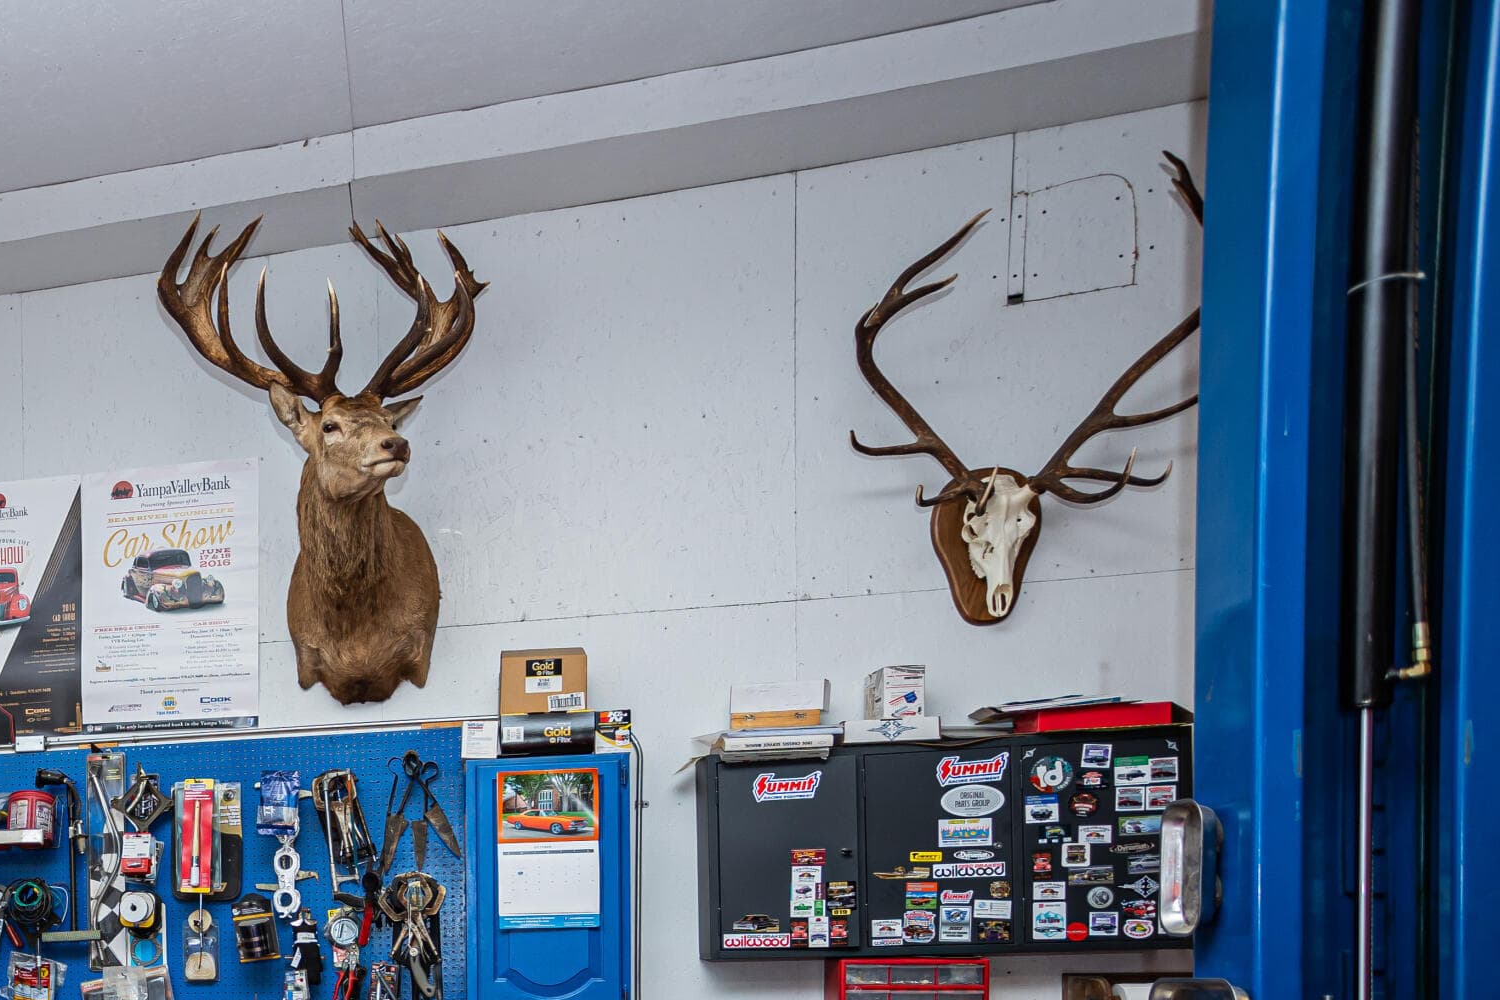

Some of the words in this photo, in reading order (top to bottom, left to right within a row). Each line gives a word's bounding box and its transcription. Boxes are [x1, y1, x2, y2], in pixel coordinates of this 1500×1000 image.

[135, 475, 231, 499] YampaValleyBank
[108, 516, 135, 524] BEAR
[136, 513, 169, 521] RIVER
[173, 509, 208, 517] YOUNG
[209, 507, 234, 515] LIFE
[103, 528, 155, 568] Car
[160, 519, 236, 550] Show
[200, 547, 231, 555] JUNE
[200, 560, 231, 568] 2016
[531, 661, 555, 672] Gold
[126, 723, 137, 731] only
[137, 722, 154, 730] locally
[200, 719, 218, 728] Yampa
[218, 719, 234, 727] Valley
[543, 726, 572, 737] Gold
[939, 758, 1002, 780] SUMMIT
[755, 774, 815, 796] SUMMIT
[959, 791, 985, 800] ORIGINAL
[954, 800, 971, 808] PARTS
[971, 799, 990, 807] GROUP
[934, 863, 1005, 879] wilwood
[724, 934, 790, 948] wilwood
